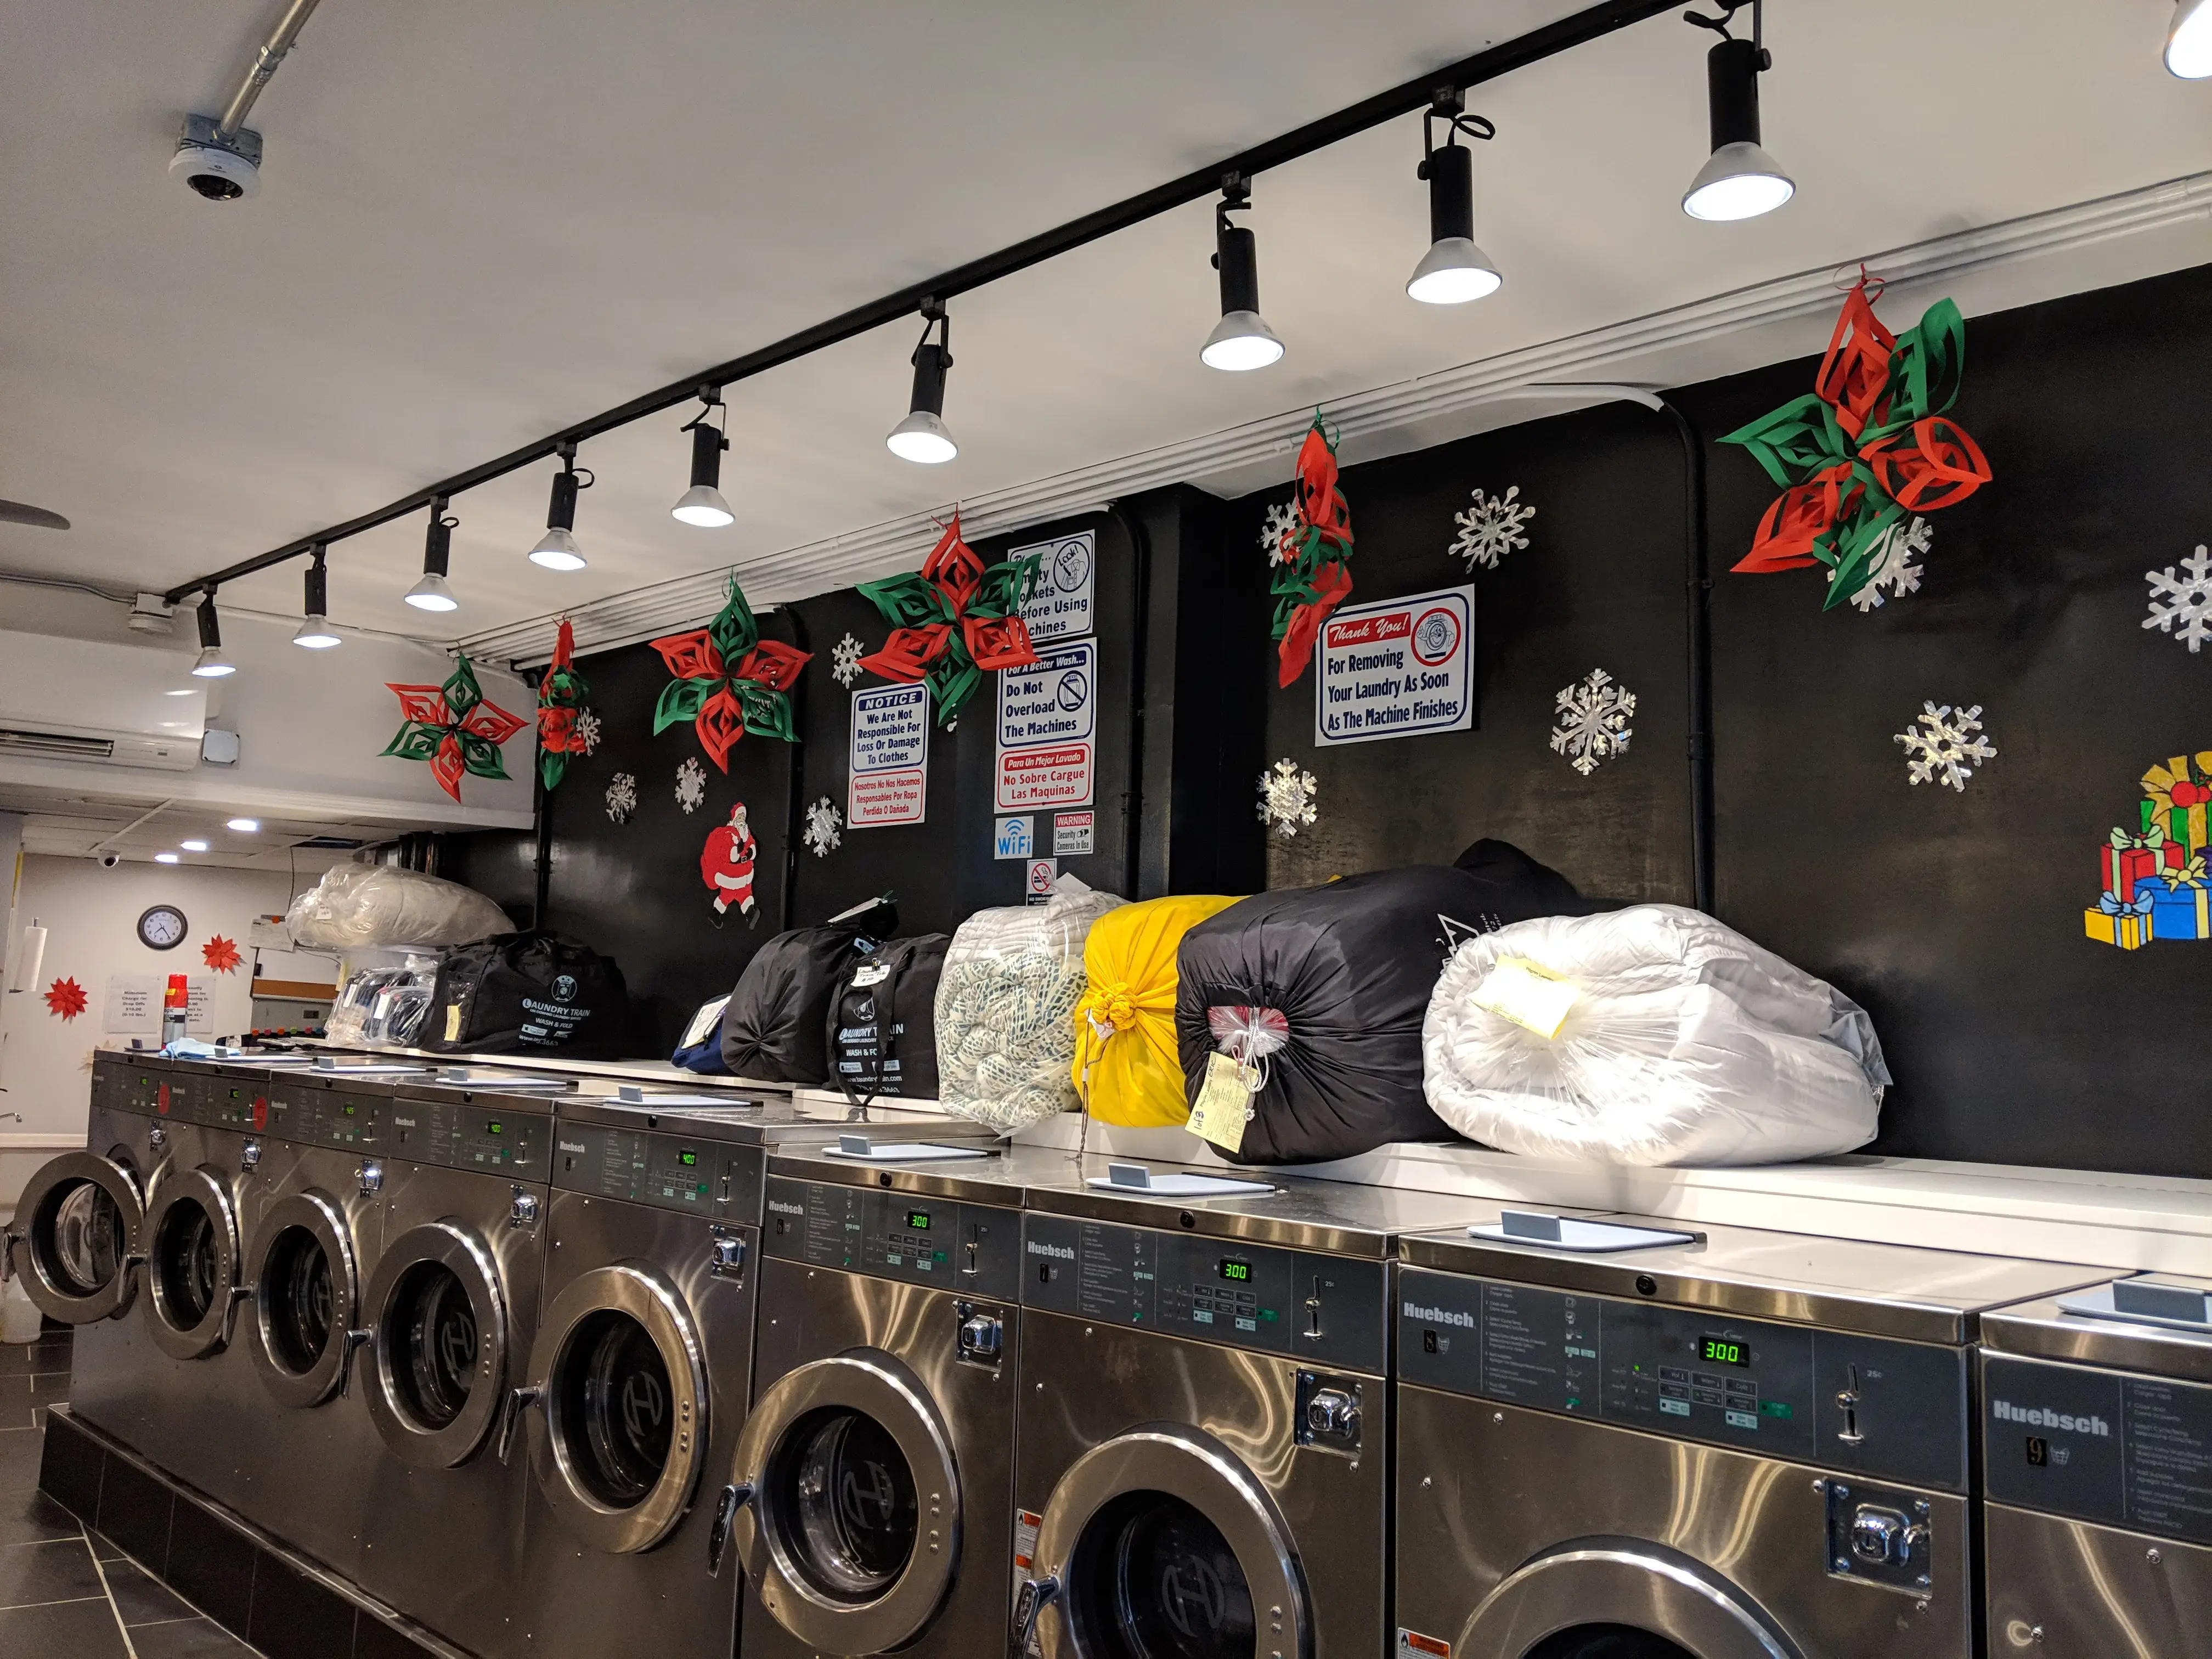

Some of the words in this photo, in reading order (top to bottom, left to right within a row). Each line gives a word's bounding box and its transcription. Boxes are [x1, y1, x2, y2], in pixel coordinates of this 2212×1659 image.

[1058, 544, 1079, 567] Look!
[1054, 598, 1088, 614] Using
[1029, 620, 1066, 636] chines
[1329, 622, 1370, 642] Thank
[1375, 614, 1409, 638] You!
[1029, 659, 1054, 671] Better
[1056, 654, 1085, 667] Wash...
[1328, 657, 1345, 676] For
[1348, 648, 1403, 673] Removing
[1006, 685, 1020, 697] Do
[1024, 681, 1043, 695] Not
[1328, 686, 1352, 703] Your
[1356, 678, 1401, 699] Laundry
[1404, 674, 1418, 693] As
[1420, 672, 1449, 691] Soon
[865, 692, 917, 710] NOTICE
[1006, 699, 1055, 718] Overload
[867, 714, 879, 724] We
[881, 713, 895, 723] Are
[898, 709, 912, 720] Not
[1328, 714, 1340, 731] As
[1343, 711, 1362, 729] The
[1365, 704, 1410, 726] Machine
[1413, 698, 1458, 720] Finishes
[857, 724, 905, 740] Responsible
[907, 722, 921, 732] For
[1005, 725, 1024, 738] The
[1027, 719, 1077, 736] Machines
[857, 742, 873, 753] Loss
[876, 740, 885, 750] Or
[888, 737, 920, 748] Damage
[867, 754, 876, 764] To
[878, 751, 909, 763] Clothes
[1008, 759, 1024, 769] Para
[1025, 758, 1034, 766] Un
[1035, 755, 1054, 767] Mejor
[1056, 752, 1081, 764] Lavado
[855, 782, 876, 791] Nosotros
[877, 780, 884, 789] No
[885, 778, 895, 788] Nos
[896, 777, 920, 787] Hacemos
[1003, 775, 1016, 786] No
[1019, 773, 1047, 785] Sobre
[1051, 770, 1085, 782] Cargue
[856, 792, 891, 805] Responsables
[893, 791, 902, 802] Por
[904, 791, 917, 801] Ropa
[1012, 789, 1026, 799] Las
[1030, 785, 1075, 799] Maquinas
[862, 805, 882, 816] Perdida
[884, 805, 888, 814] O
[889, 804, 909, 814] Dañada
[1057, 815, 1091, 826] WARNING
[1057, 830, 1075, 840] Security
[998, 836, 1030, 855] WiFi
[1057, 842, 1075, 850] Cameras
[522, 998, 569, 1015] LAUNDRY
[571, 1008, 591, 1017] TRAIN
[535, 1017, 554, 1026] WASH
[839, 1026, 872, 1040] LAUNDRY
[846, 1048, 862, 1057] WASH
[1208, 1057, 1216, 1077] ERIC
[683, 1154, 695, 1165] 400
[769, 1200, 804, 1215] Huebsch
[912, 1215, 928, 1228] 300
[1028, 1241, 1074, 1260] Huebsch
[1226, 1263, 1246, 1279] 300
[1404, 1302, 1474, 1328] Huebsch
[1706, 1342, 1739, 1362] 300
[1993, 1400, 2109, 1436] Huebsch
